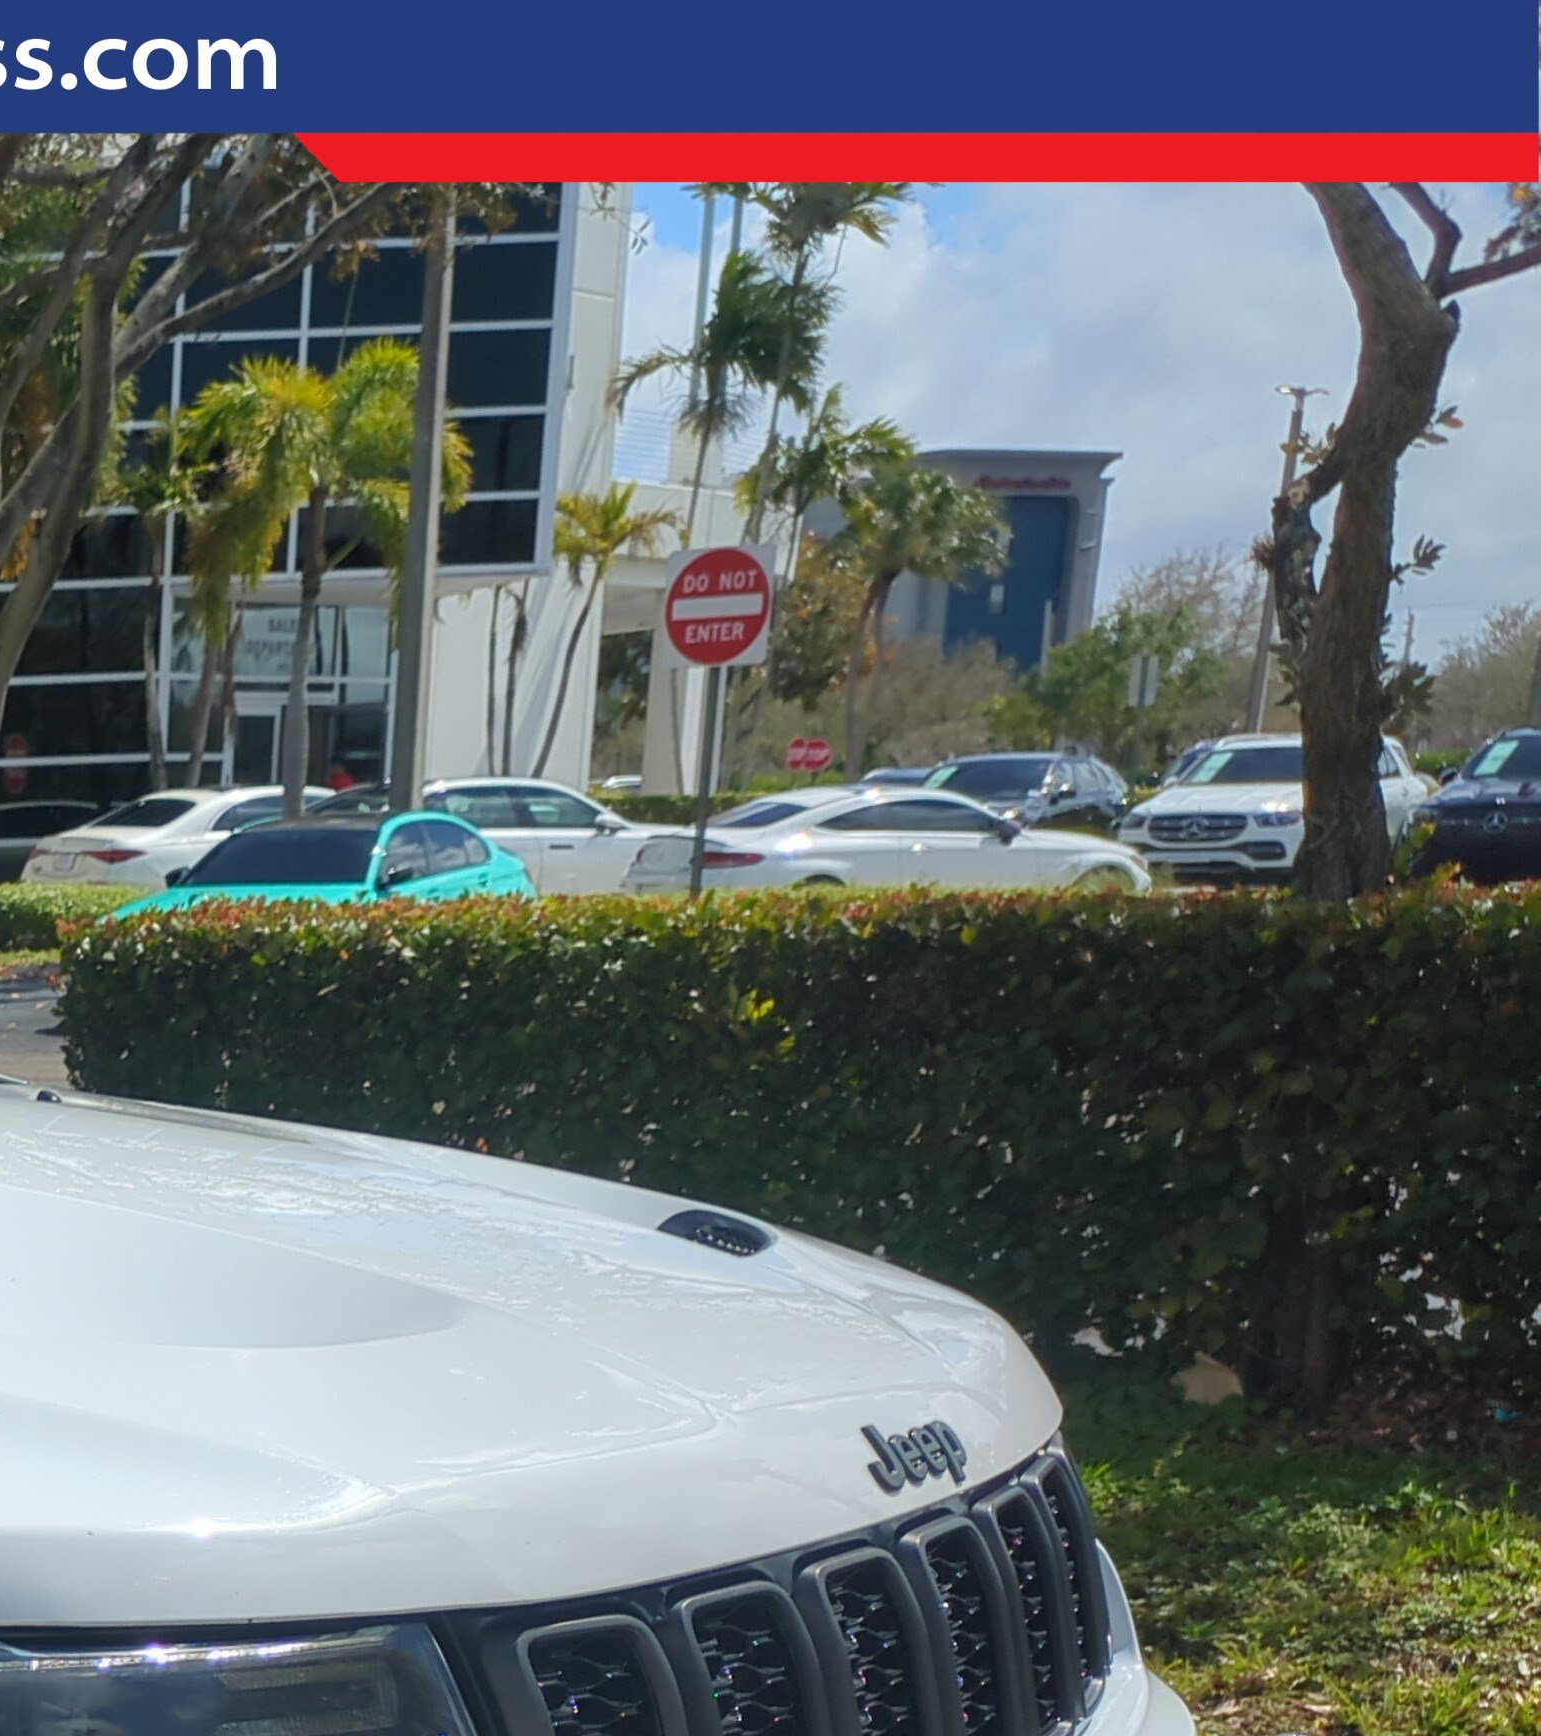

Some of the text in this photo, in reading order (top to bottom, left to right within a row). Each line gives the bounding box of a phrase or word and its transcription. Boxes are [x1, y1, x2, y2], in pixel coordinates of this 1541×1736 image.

[683, 570, 757, 594] DO NOT
[685, 621, 745, 644] ENTER
[860, 1420, 967, 1496] Jeep
